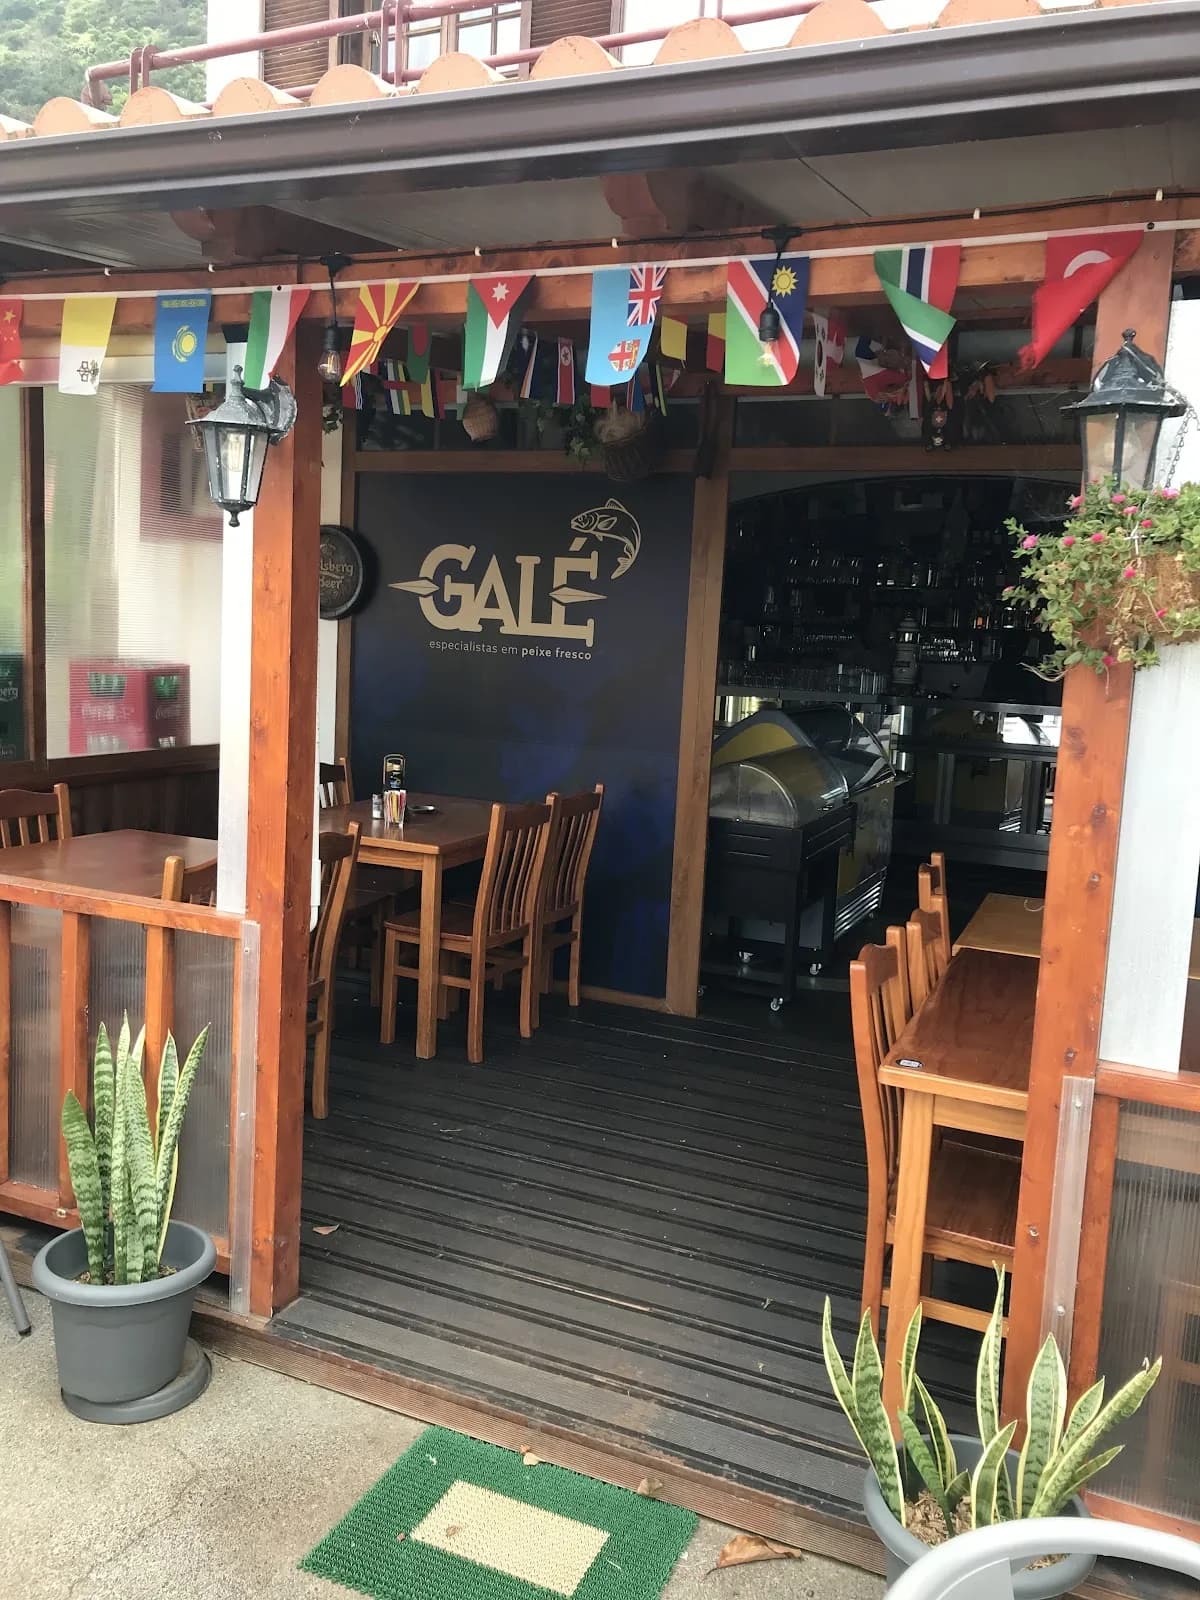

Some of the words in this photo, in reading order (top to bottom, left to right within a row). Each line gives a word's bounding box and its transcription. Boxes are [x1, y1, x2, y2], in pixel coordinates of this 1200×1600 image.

[320, 558, 353, 576] lsberg
[418, 537, 599, 647] GALÉ
[429, 639, 498, 654] especialistas
[501, 645, 518, 654] em
[521, 646, 552, 658] peixe
[555, 647, 592, 660] fresco
